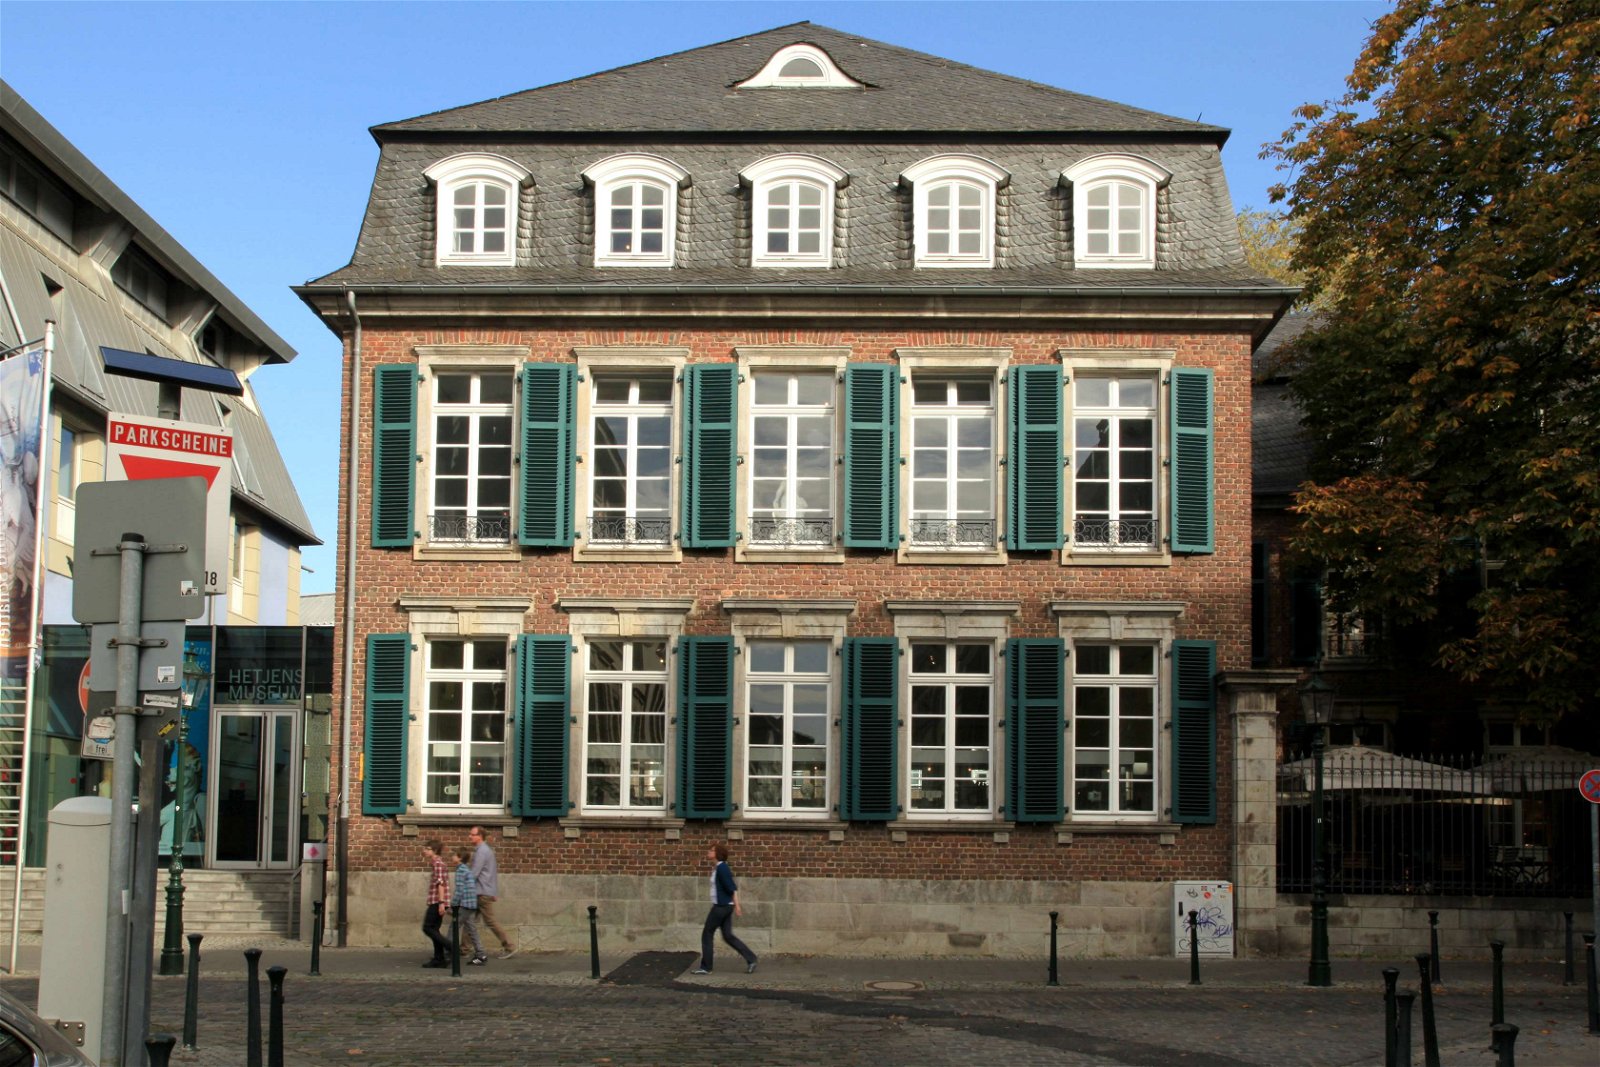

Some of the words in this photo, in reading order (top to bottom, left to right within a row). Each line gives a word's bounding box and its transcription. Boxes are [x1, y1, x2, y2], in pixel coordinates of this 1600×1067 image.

[115, 425, 228, 454] PARKSCHEINE
[204, 571, 217, 585] 18
[229, 669, 302, 684] HETJENS
[229, 685, 302, 700] MUSEUM
[95, 744, 108, 754] frei
